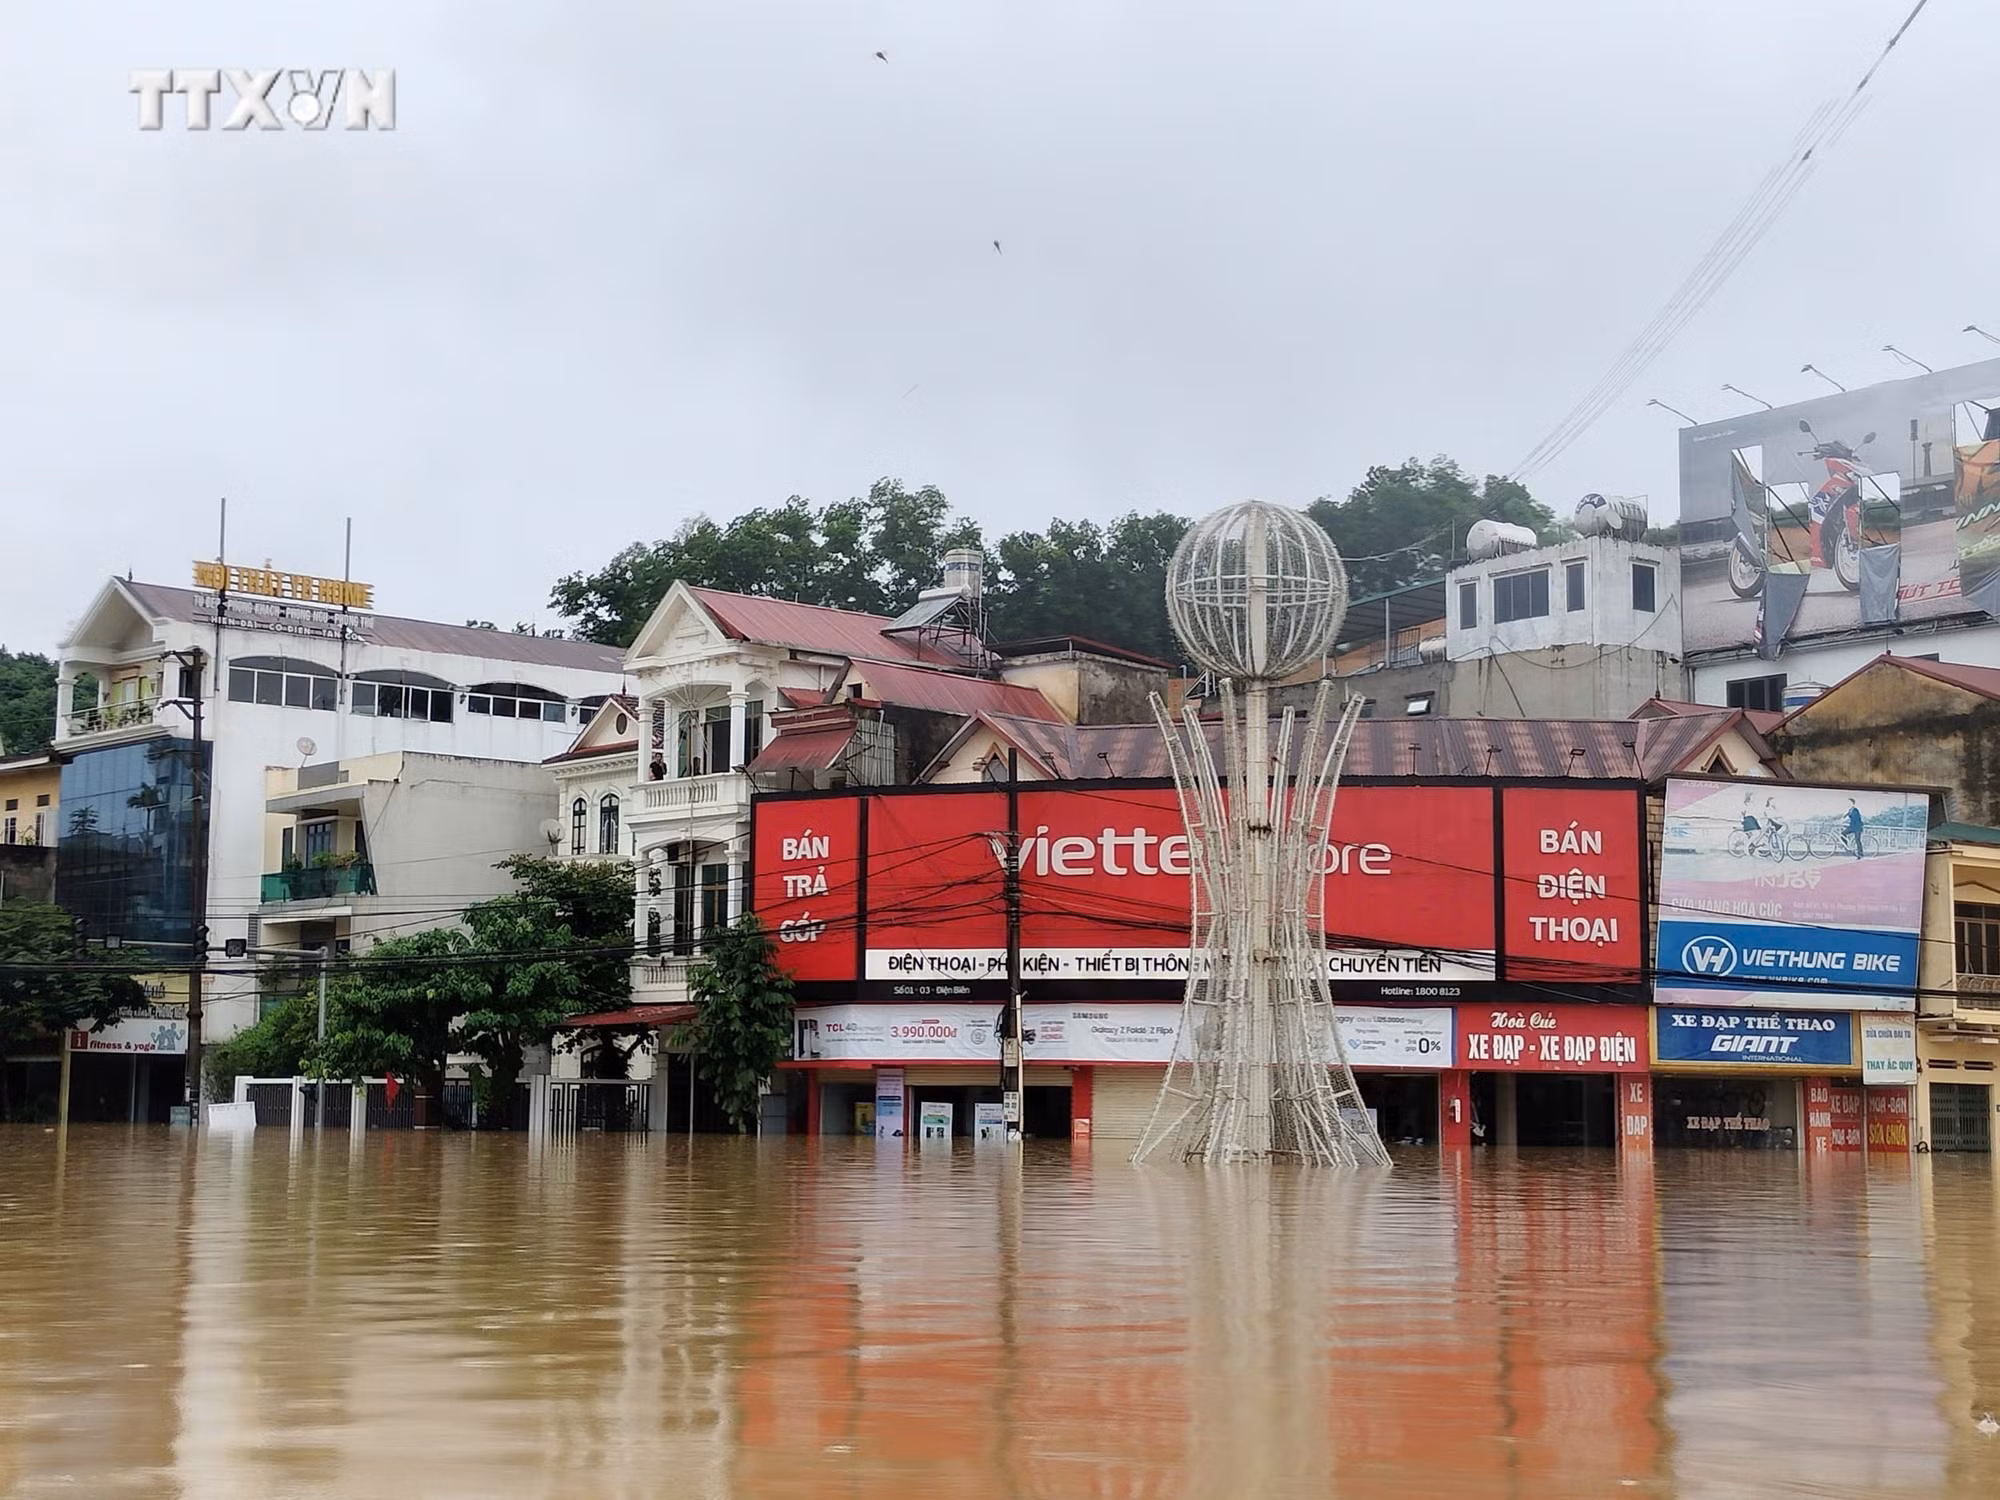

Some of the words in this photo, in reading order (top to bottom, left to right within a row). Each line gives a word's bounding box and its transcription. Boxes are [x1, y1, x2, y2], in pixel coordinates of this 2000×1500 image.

[782, 828, 829, 861] BÁN
[1540, 820, 1602, 855] BÁN
[989, 825, 1202, 876] viette
[782, 865, 830, 898] TRẢ
[1537, 867, 1606, 905] ĐIỆN
[1528, 917, 1618, 947] THOẠI
[888, 953, 923, 974] ĐIỆN
[928, 957, 976, 974] THOẠI
[988, 957, 1009, 972] PH
[1023, 953, 1060, 975] KIỆN
[1075, 949, 1122, 972] THIẾT
[1125, 957, 1139, 975] BỊ
[1742, 948, 1847, 970] VIETHUNG
[1852, 953, 1901, 973] BIKE
[1381, 986, 1414, 996] Hotline:
[1416, 987, 1438, 996] 1800
[1439, 987, 1460, 996] 8123
[826, 1024, 844, 1032] TCL
[890, 1026, 957, 1038] 3.990.000đ
[1091, 1026, 1118, 1036] Galaxy
[1671, 1014, 1697, 1028] XE
[1701, 1015, 1741, 1031] ĐẠP
[1785, 1018, 1836, 1032] THAO
[89, 1041, 122, 1050] fitness
[134, 1043, 155, 1052] yoga
[1419, 1037, 1441, 1054] 0%
[1468, 1034, 1489, 1060] XE
[1493, 1034, 1525, 1065] ĐẠP
[1539, 1035, 1560, 1061] XE
[1564, 1036, 1596, 1066] ĐẠP
[1600, 1031, 1636, 1067] ĐIỆN
[1711, 1034, 1799, 1054] GIANT
[1742, 1055, 1803, 1063] INTERNATIONAL
[1867, 1060, 1885, 1070] THAY
[1630, 1083, 1643, 1102] XE
[1627, 1115, 1648, 1140] ĐẠP
[1686, 1116, 1700, 1129] XE
[1744, 1117, 1770, 1130] THAO
[1816, 1136, 1827, 1152] XE
